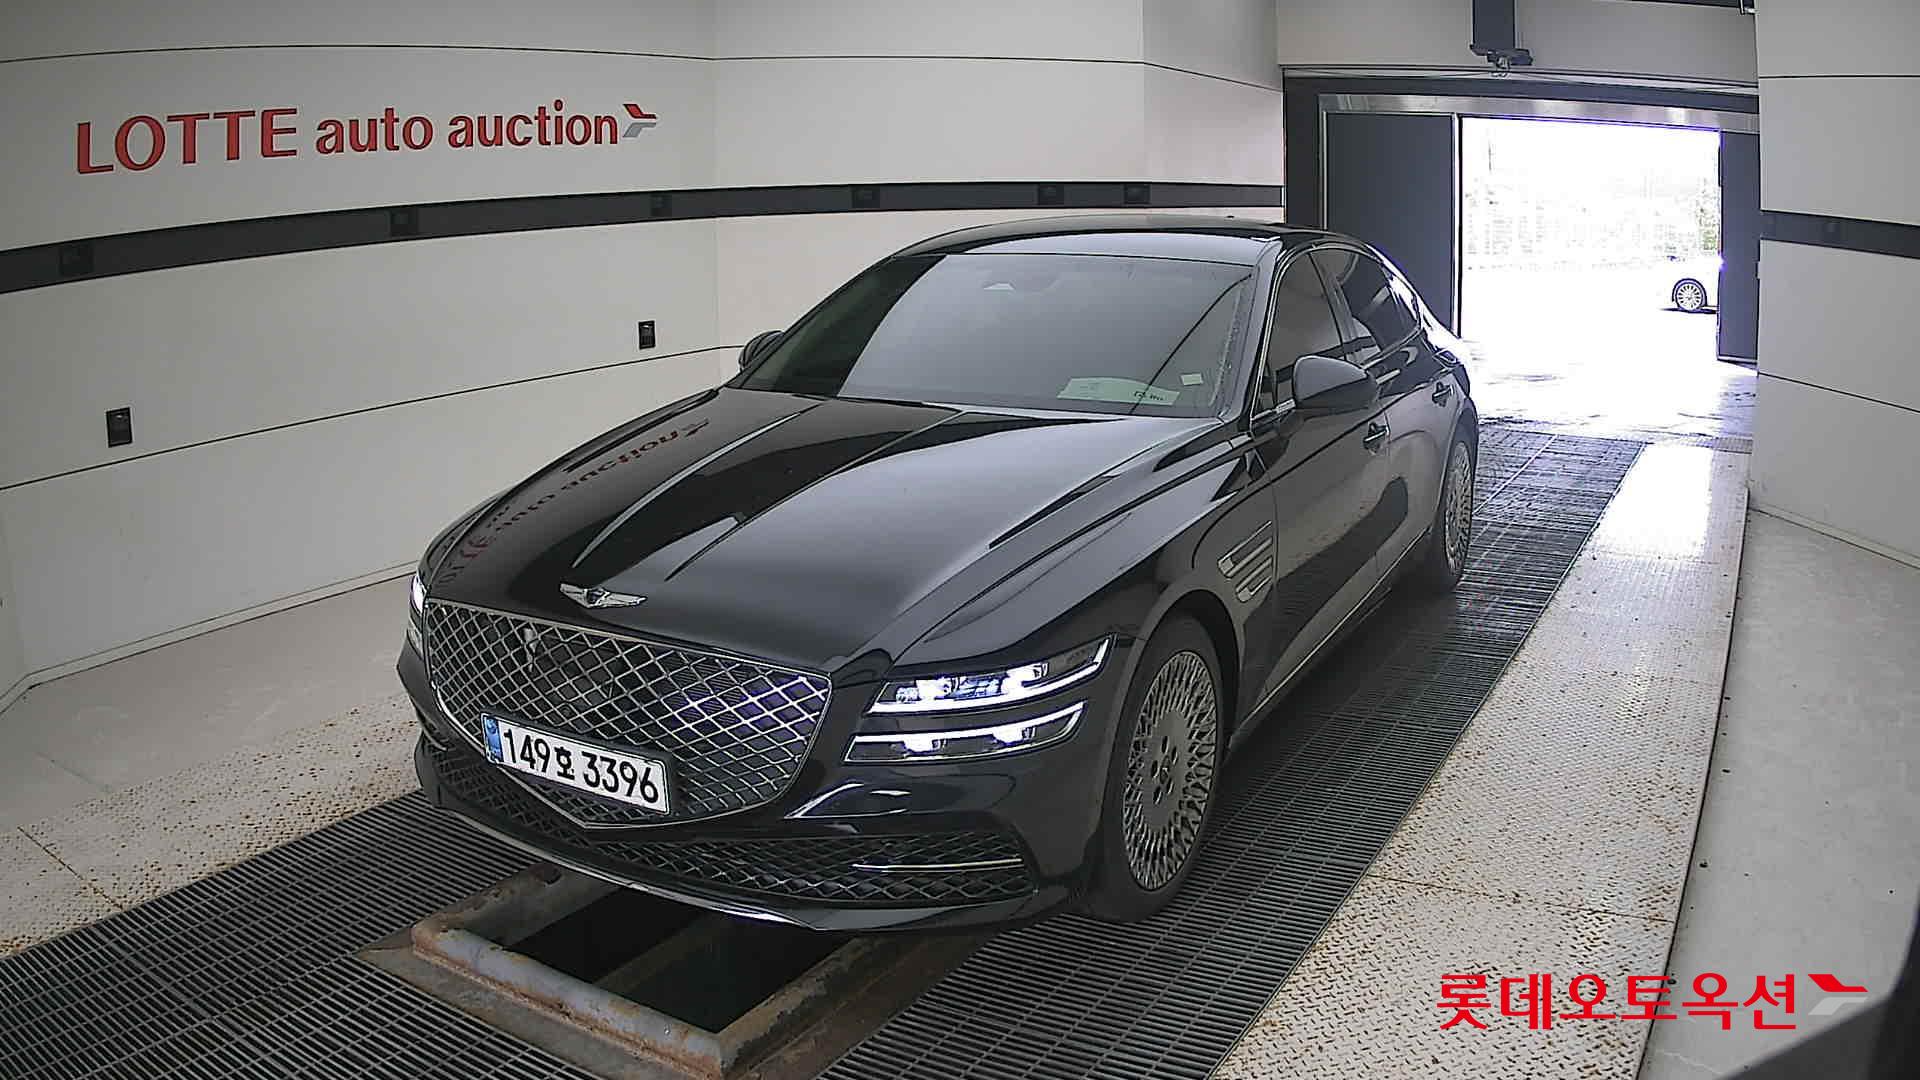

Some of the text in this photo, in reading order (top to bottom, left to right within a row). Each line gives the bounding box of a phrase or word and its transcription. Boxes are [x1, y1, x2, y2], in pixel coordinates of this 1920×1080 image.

[76, 99, 619, 174] LOTTE auto auction
[503, 728, 659, 804] 149호 3396
